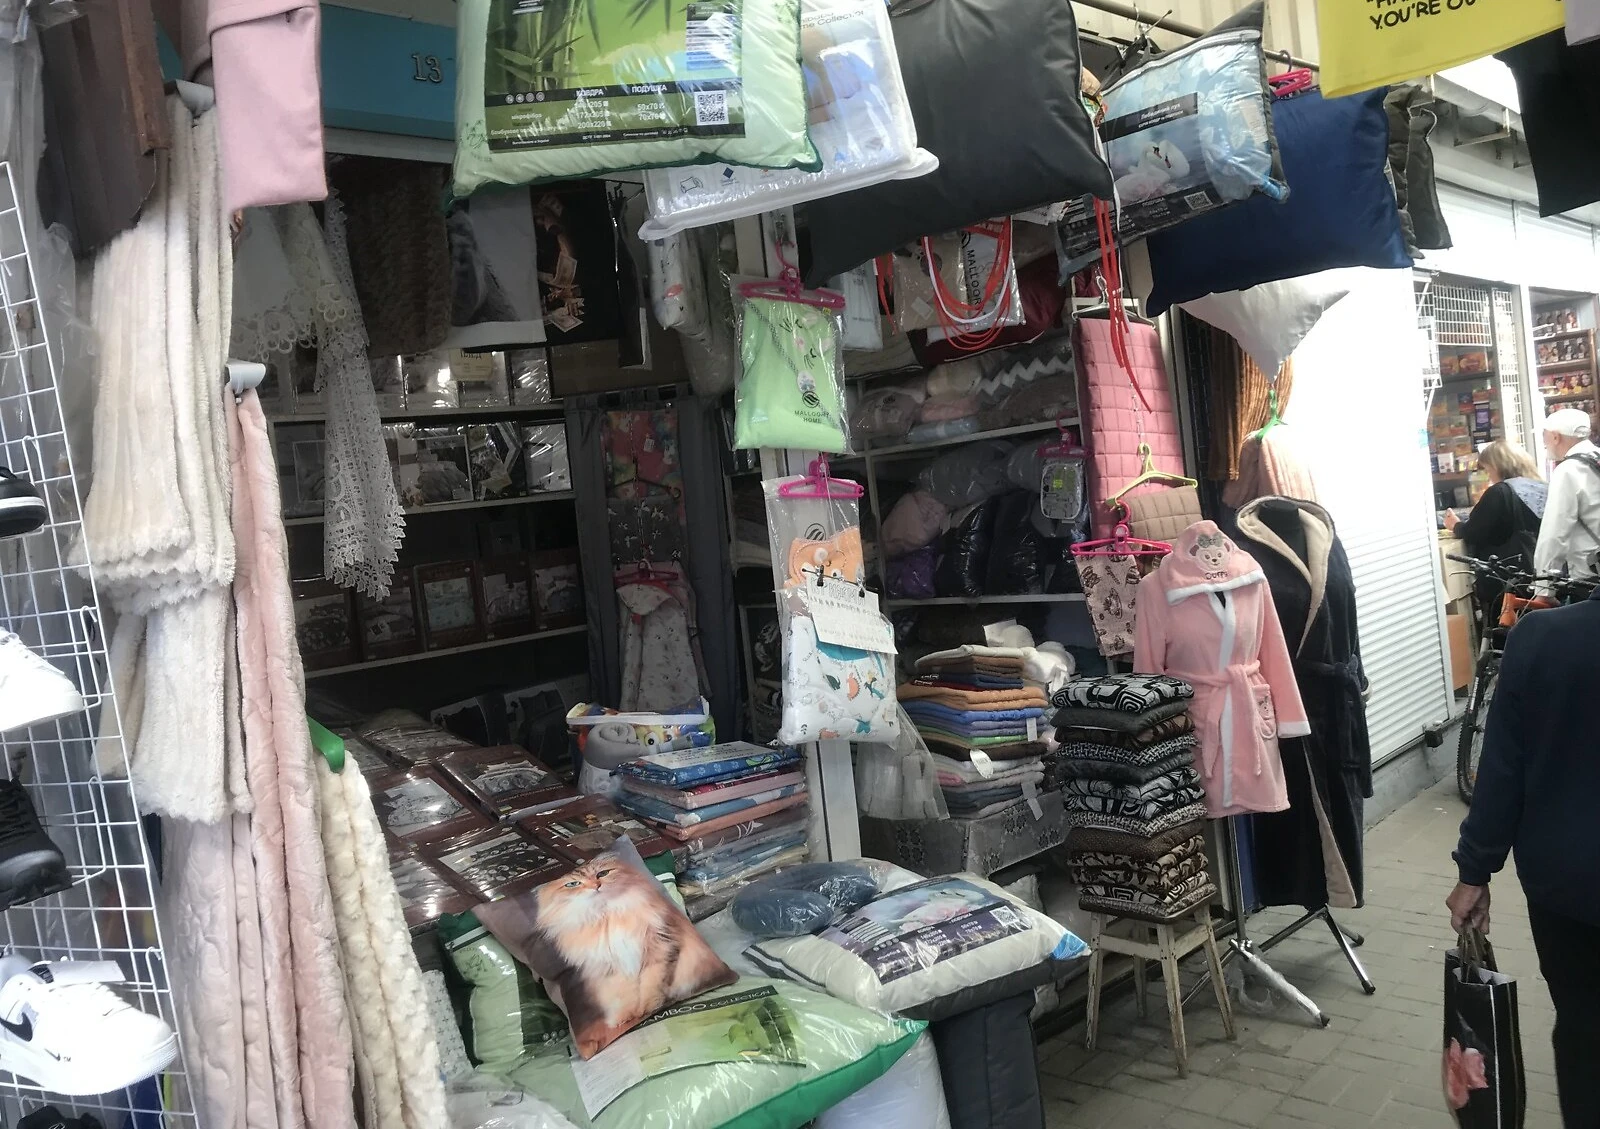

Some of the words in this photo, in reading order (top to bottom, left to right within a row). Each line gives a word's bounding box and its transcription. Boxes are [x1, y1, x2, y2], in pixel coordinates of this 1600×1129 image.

[1369, 0, 1441, 29] YOU'RE
[411, 53, 443, 84] 13
[631, 83, 668, 95] ПОДУШКА
[640, 1004, 706, 1028] AMBOO
[709, 989, 772, 1008] COLLECTION
